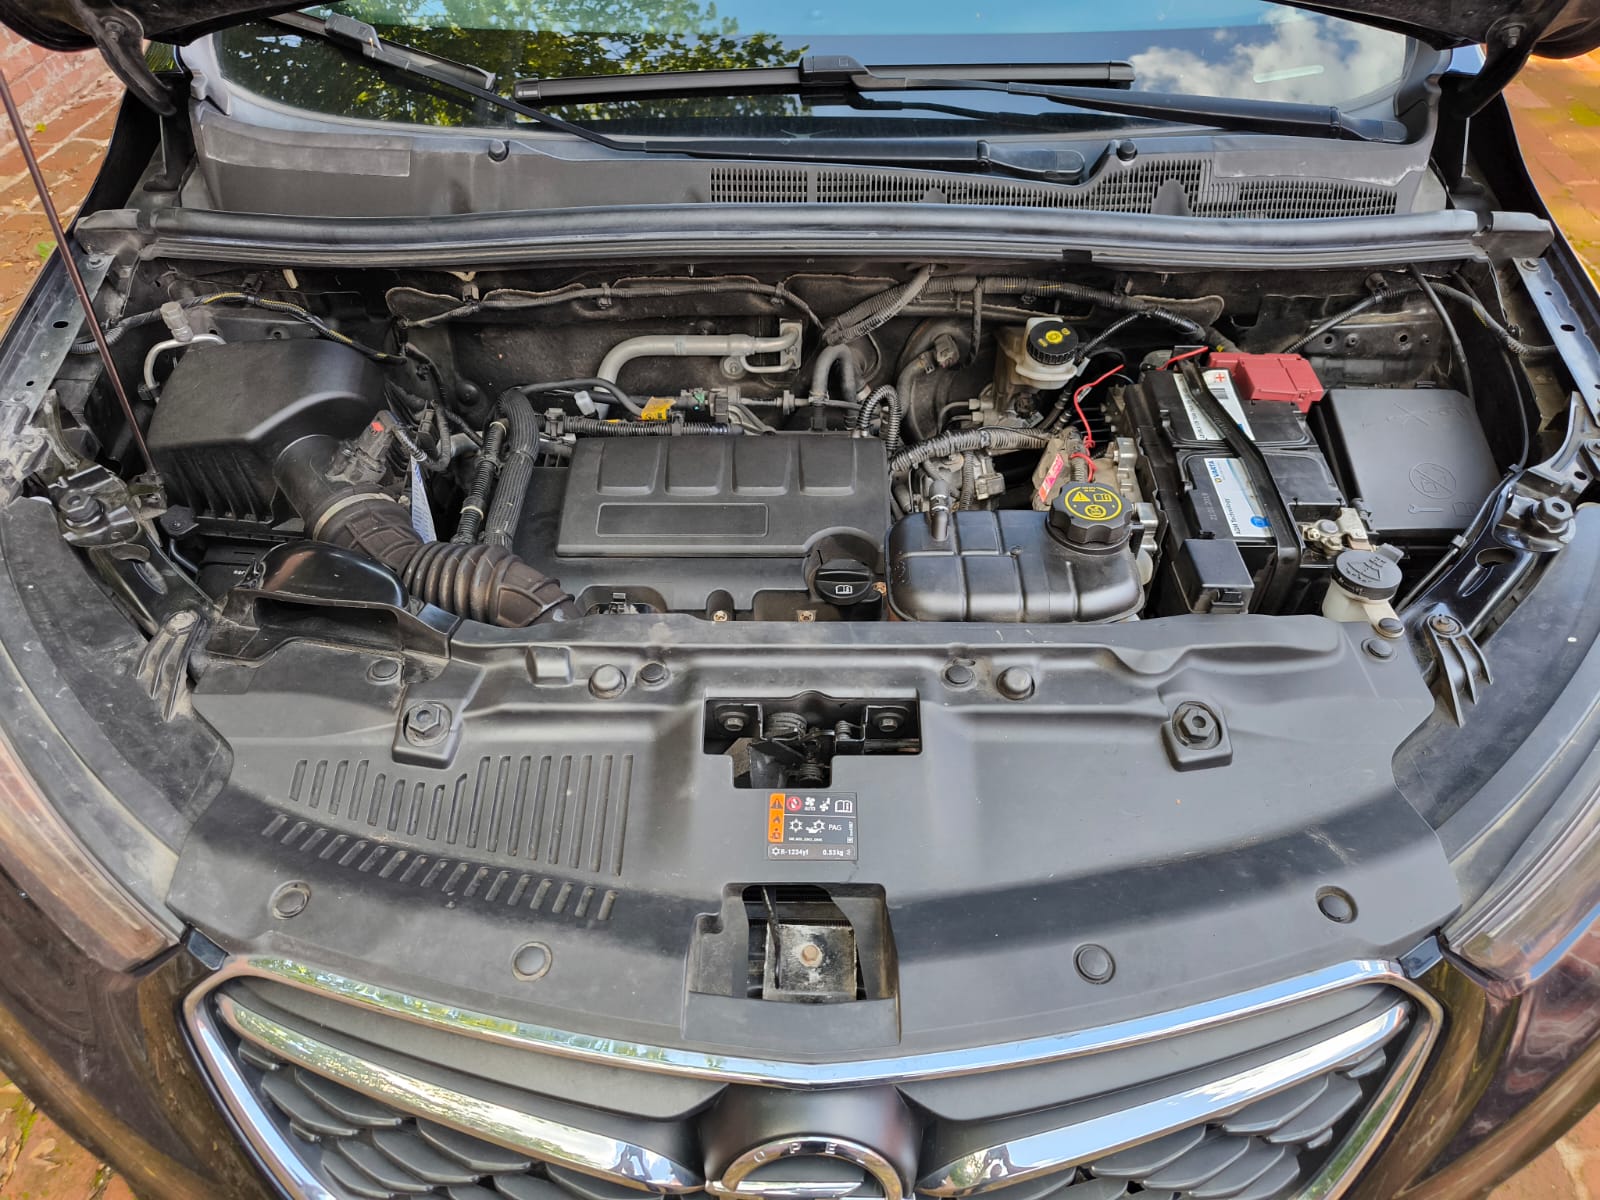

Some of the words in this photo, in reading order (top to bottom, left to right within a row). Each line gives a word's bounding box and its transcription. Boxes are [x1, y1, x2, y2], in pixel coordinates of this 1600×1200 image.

[1208, 460, 1219, 478] VARTA
[1225, 498, 1238, 524] Technology
[780, 848, 809, 857] R-1234yf
